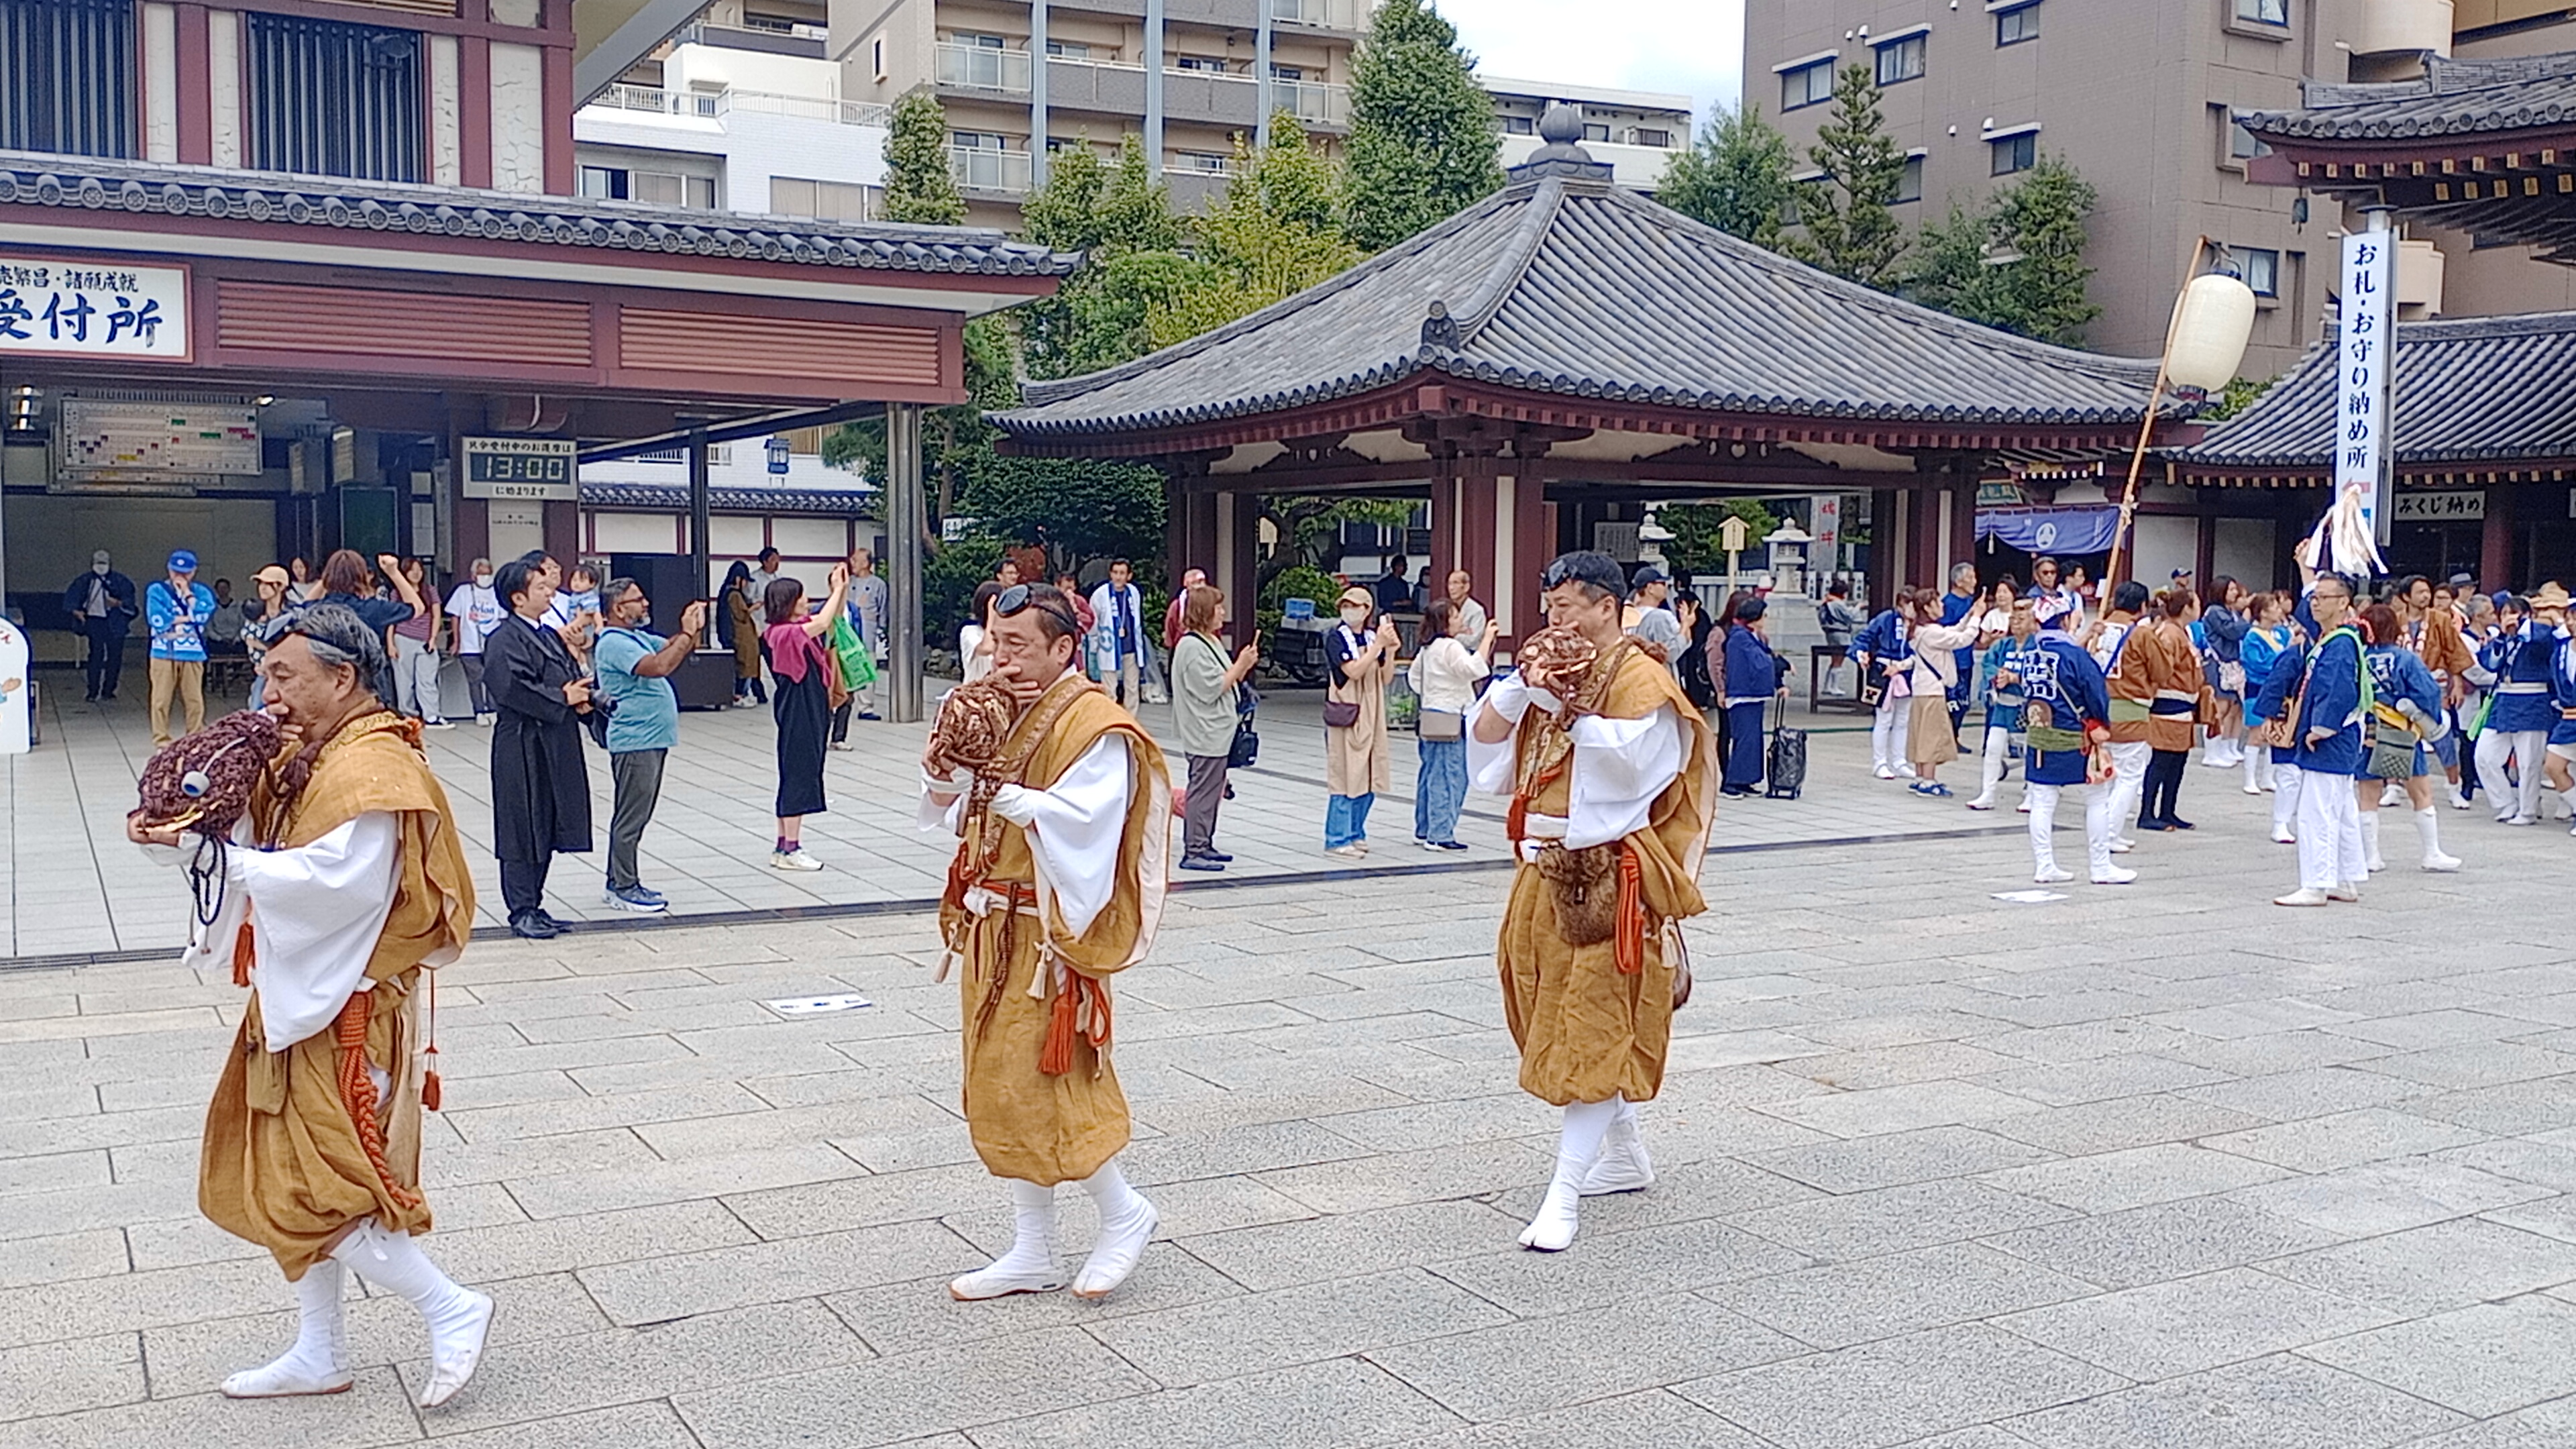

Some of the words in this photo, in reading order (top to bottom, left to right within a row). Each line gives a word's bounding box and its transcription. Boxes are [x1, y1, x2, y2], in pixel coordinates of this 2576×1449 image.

[0, 288, 163, 348] 受付所
[2346, 243, 2377, 469] お札・お守り納め所
[486, 456, 564, 480] 13:00
[495, 486, 546, 496] に始まります
